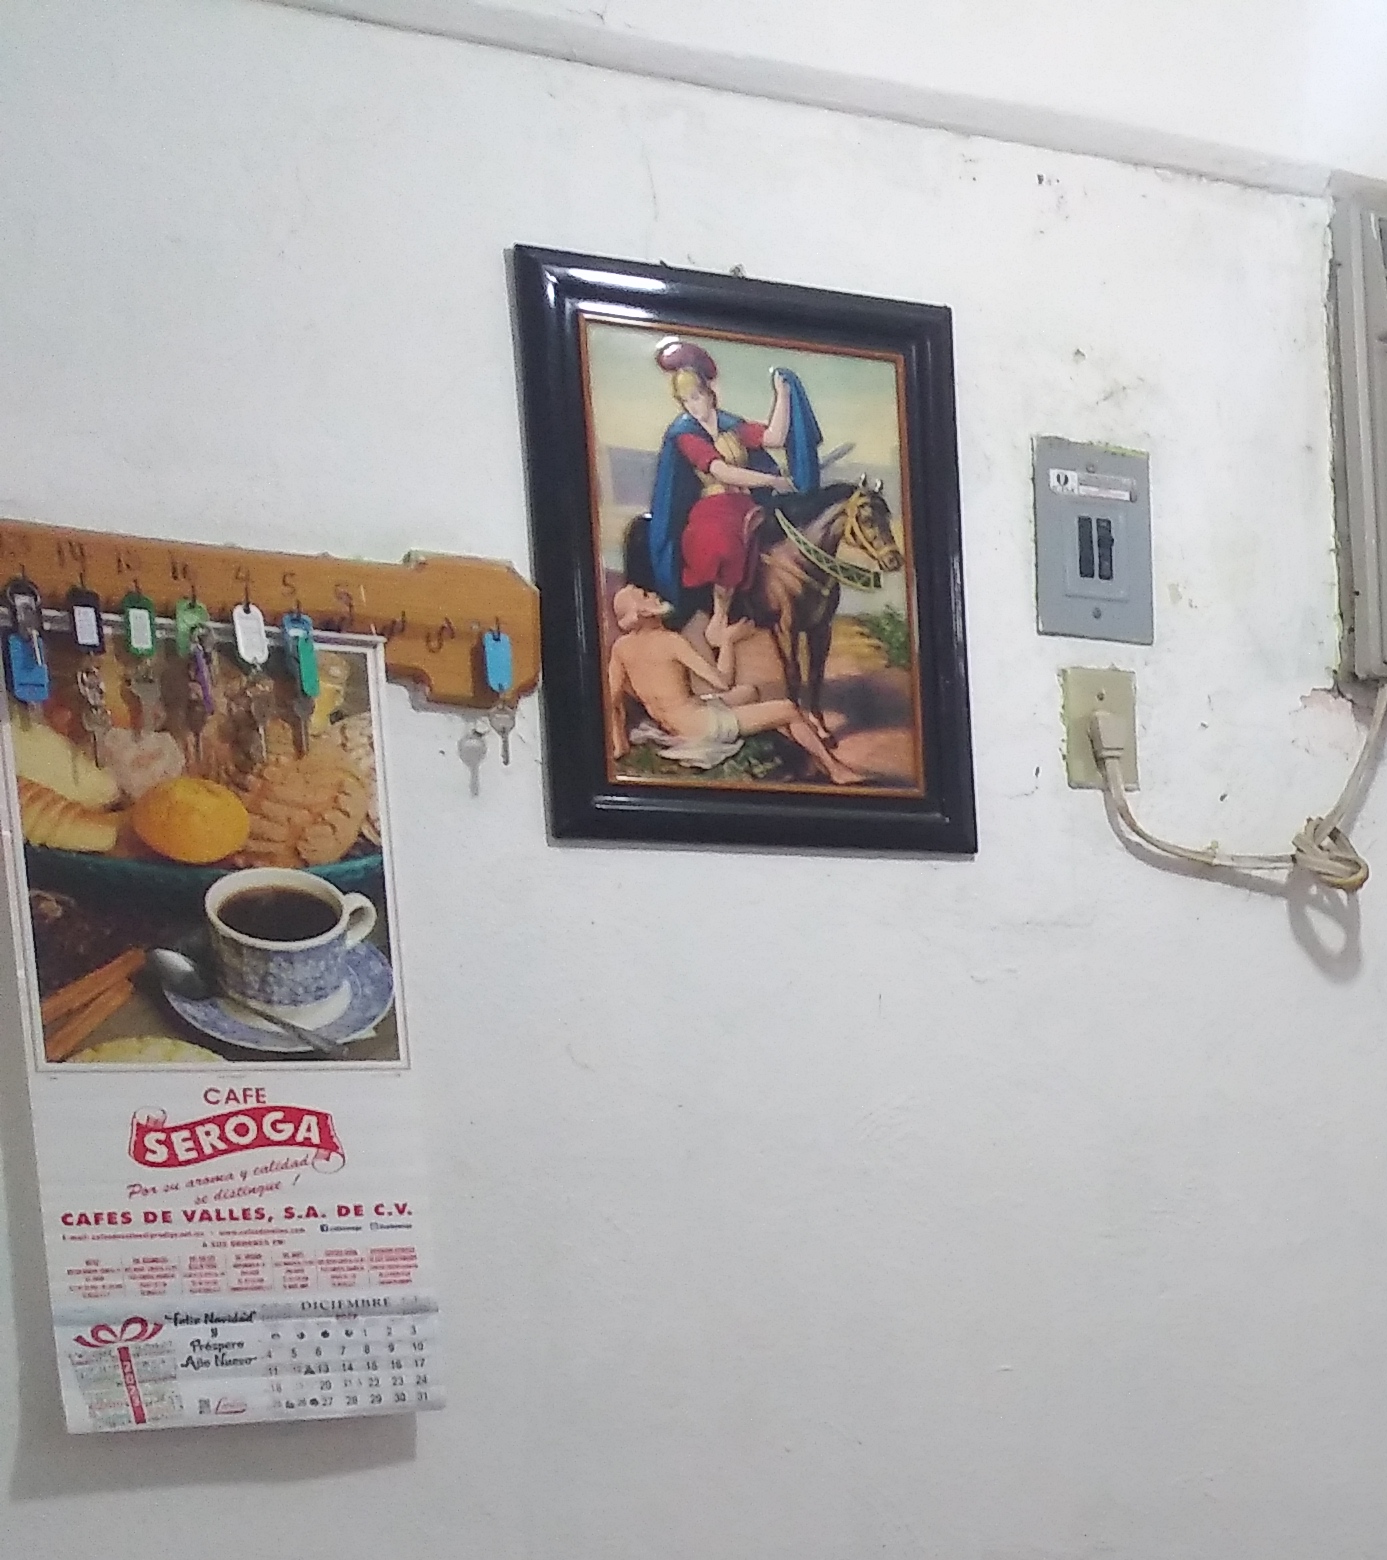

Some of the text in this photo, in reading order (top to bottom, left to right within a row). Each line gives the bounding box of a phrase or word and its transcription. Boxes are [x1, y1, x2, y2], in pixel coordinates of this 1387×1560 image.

[203, 1087, 267, 1105] CAFE
[144, 1111, 321, 1163] SEROGA
[126, 1154, 310, 1199] Por su aroma y calidad
[213, 1180, 282, 1202] distingue
[61, 1202, 413, 1226] CAFES DE VALLES, S.A. DE C.V.
[301, 1296, 390, 1311] DICIEMBRE
[203, 1310, 256, 1325] Navidad
[291, 1347, 298, 1359] 5
[315, 1346, 322, 1357] 6
[340, 1345, 346, 1355] 7
[364, 1343, 371, 1355] 8
[388, 1342, 395, 1353] 9
[412, 1341, 424, 1351] 10
[342, 1362, 354, 1373] 14
[414, 1358, 426, 1368] 17
[320, 1380, 332, 1391] 20
[416, 1374, 428, 1386] 24
[321, 1396, 333, 1407] 27
[370, 1393, 382, 1404] 29
